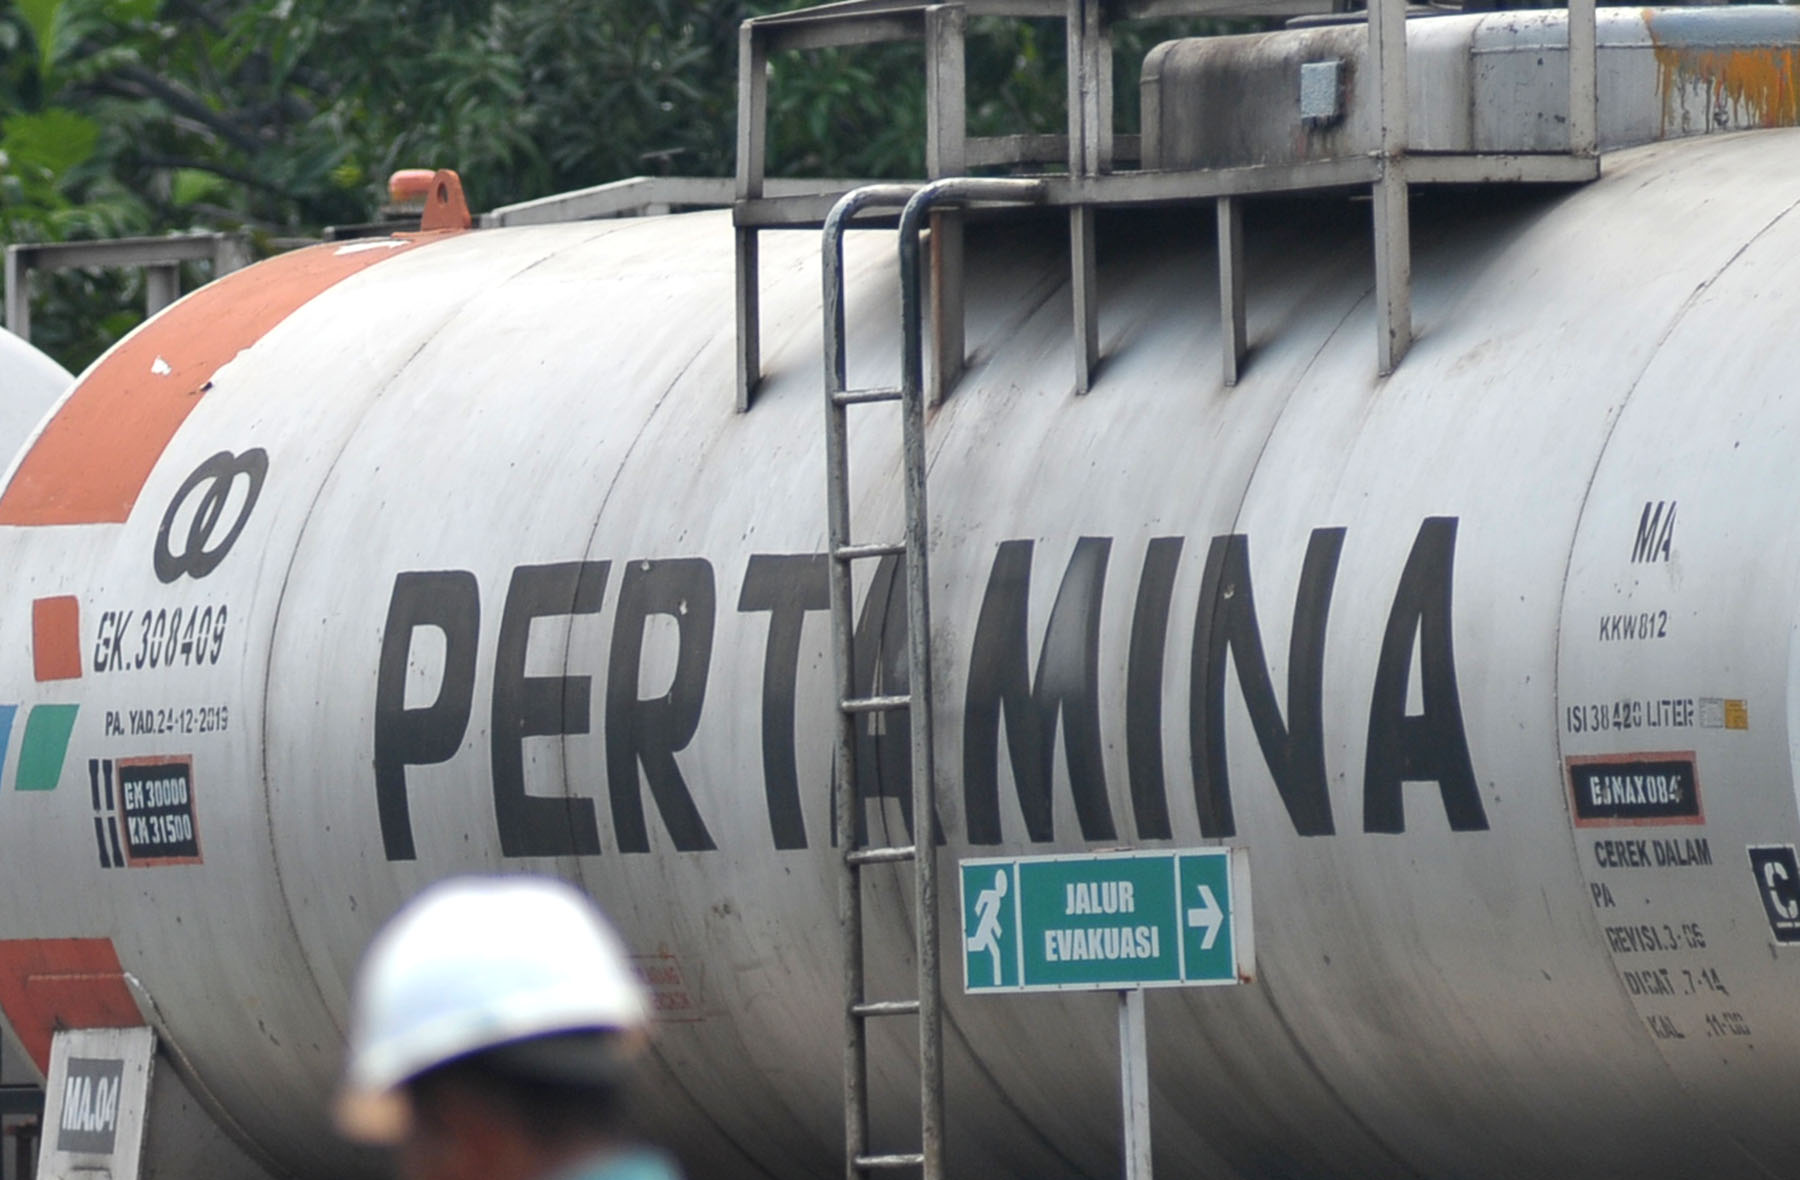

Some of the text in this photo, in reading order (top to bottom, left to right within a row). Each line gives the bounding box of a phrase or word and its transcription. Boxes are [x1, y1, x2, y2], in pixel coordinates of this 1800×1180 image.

[1630, 500, 1677, 564] MA
[93, 604, 228, 672] GK.308409
[1647, 699, 1694, 727] LITER
[146, 777, 188, 808] 30000
[150, 814, 192, 844] 31500
[1594, 837, 1713, 869] CEREK DALAM
[1065, 880, 1135, 916] JALUR
[1591, 882, 1616, 909] PA
[1763, 861, 1799, 919] C
[1044, 925, 1160, 962] EVAKUASI
